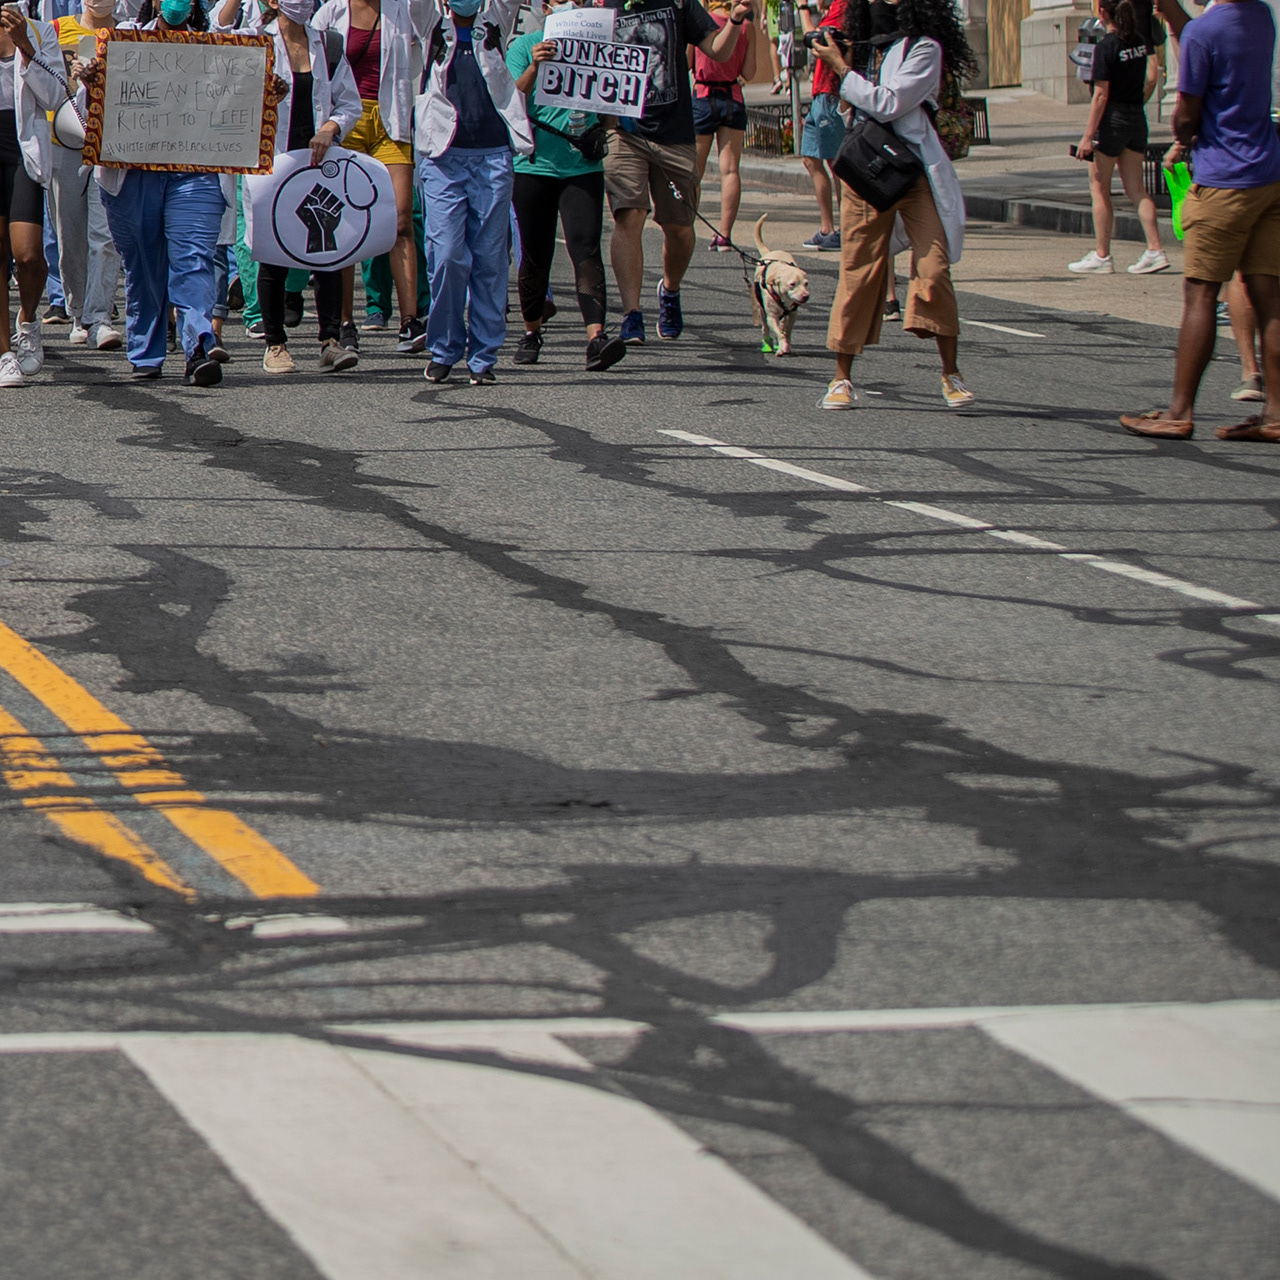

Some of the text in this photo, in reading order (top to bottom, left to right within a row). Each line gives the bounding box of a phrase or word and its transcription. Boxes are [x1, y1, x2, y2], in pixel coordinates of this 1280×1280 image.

[555, 20, 603, 29] White Coats
[657, 10, 671, 19] On!
[563, 30, 585, 38] Black
[586, 31, 607, 41] Lives
[124, 50, 257, 76] BLACK LIVES
[551, 39, 645, 73] BUNKER
[120, 80, 244, 111] HAVE AN EQUAL
[542, 62, 640, 107] BITCH
[117, 107, 254, 135] RIGHT TO LIFE!
